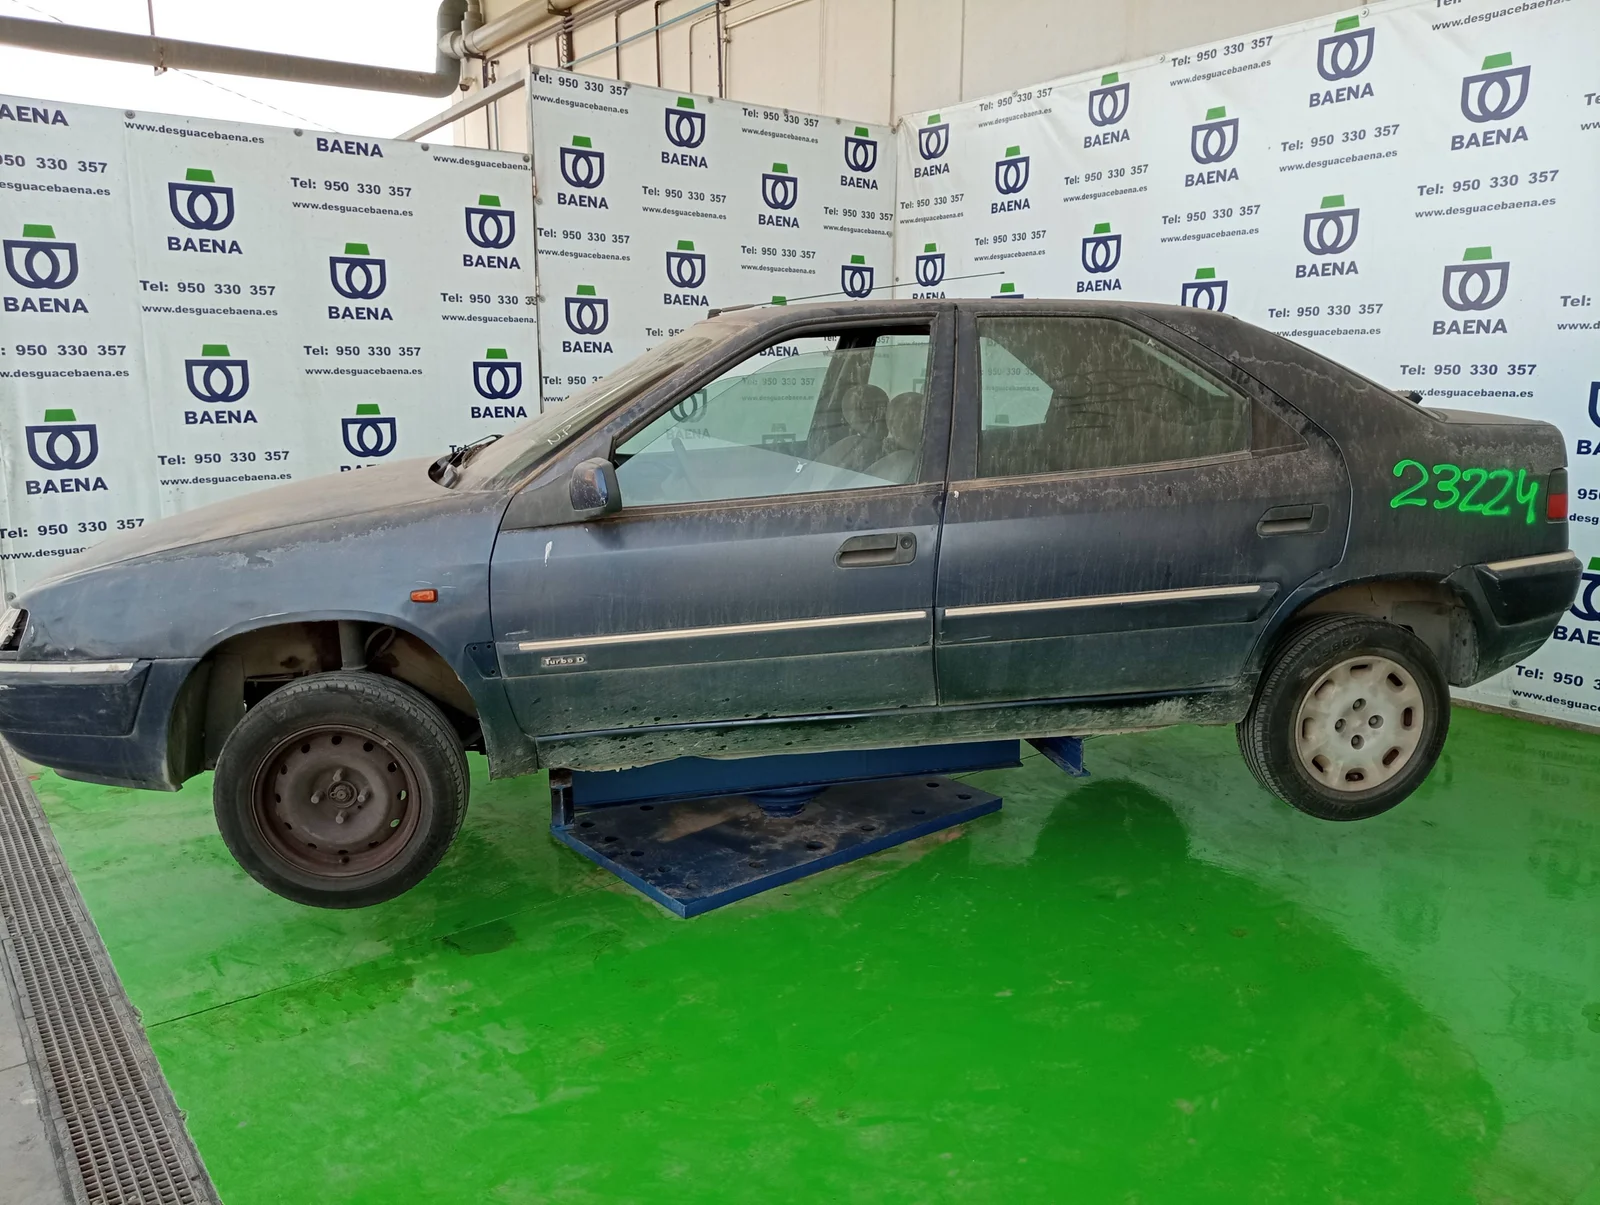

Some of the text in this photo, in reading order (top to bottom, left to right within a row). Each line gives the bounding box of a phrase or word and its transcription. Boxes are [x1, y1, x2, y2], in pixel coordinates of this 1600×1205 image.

[1172, 35, 1273, 68] Tel: 950 330 357
[1170, 59, 1271, 87] www.desguacebaena.es
[532, 72, 628, 96] Tel: 950 330 357
[979, 88, 1053, 112] Tel: 950 330 357
[1309, 82, 1374, 108] BAENA
[533, 94, 629, 114] www.desguacebaena.es
[742, 108, 819, 128] Tel: 950 330 357
[978, 107, 1052, 128] www.desguacebaena.es
[125, 121, 264, 144] www.desguacebaena.es
[742, 127, 818, 144] www.desguacebaena.es
[1084, 129, 1130, 149] BAENA
[1281, 124, 1400, 152] Tel: 950 330 357
[1451, 126, 1528, 151] BAENA
[316, 137, 383, 158] BAENA
[36, 157, 108, 173] 330 357
[661, 151, 708, 168] BAENA
[1279, 150, 1397, 172] www.desguacebaena.es
[914, 163, 950, 178] BAENA
[1064, 164, 1149, 185] Tel: 950 330 357
[1185, 167, 1239, 187] BAENA
[291, 177, 412, 197] Tel: 950 330 357
[841, 175, 878, 190] BAENA
[1417, 170, 1559, 196] Tel: 950 330 357
[557, 192, 609, 209] BAENA
[642, 186, 726, 203] Tel: 950 330 357
[900, 193, 964, 210] Tel: 950 330 357
[1063, 185, 1148, 203] www.desguacebaena.es
[292, 202, 413, 217] www.desguacebaena.es
[642, 206, 726, 220] www.desguacebaena.es
[824, 207, 893, 221] Tel: 950 330 357
[991, 198, 1030, 214] BAENA
[1415, 198, 1556, 218] www.desguacebaena.es
[759, 214, 799, 228] BAENA
[900, 211, 963, 224] www.desguacebaena.es
[1162, 204, 1261, 225] Tel: 950 330 357
[537, 228, 630, 244] Tel: 950 330 357
[975, 230, 1047, 246] Tel: 950 330 357
[1161, 227, 1259, 243] www.desguacebaena.es
[168, 237, 243, 254] BAENA
[741, 246, 815, 259] Tel: 950 330 357
[463, 254, 521, 269] BAENA
[538, 249, 630, 261] www.desguacebaena.es
[974, 249, 1045, 262] www.desguacebaena.es
[741, 264, 815, 274] www.desguacebaena.es
[1296, 261, 1359, 279] BAENA
[139, 280, 276, 296] Tel: 950 330 357
[1077, 278, 1122, 293] BAENA
[4, 297, 89, 313] BAENA
[441, 293, 463, 302] Tel:
[469, 295, 491, 304] 950
[498, 296, 518, 305] 330
[664, 294, 709, 306] BAENA
[1560, 295, 1592, 307] Tel:
[142, 305, 278, 316] www.desguacebaena.es
[328, 306, 393, 321] BAENA
[1268, 303, 1383, 318] Tel: 950 330 357
[646, 328, 663, 337] Tel:
[1433, 319, 1508, 335] BAENA
[15, 345, 127, 356] 950 330 357
[304, 346, 421, 356] Tel: 950 330 357
[562, 341, 613, 353] BAENA
[305, 368, 423, 376] www.desguacebaena.es
[1401, 364, 1537, 376] Tel: 950 330 357
[543, 376, 561, 385] Tel:
[568, 376, 586, 385] 950
[184, 410, 258, 425] BAENA
[471, 406, 527, 418] BAENA
[158, 451, 290, 465] Tel: 950 330 357
[26, 477, 109, 495] BAENA
[160, 473, 292, 485] www.desguacebaena.es
[1390, 459, 1538, 524] 23224
[0, 518, 145, 539] Tel: 950 330 357
[1516, 665, 1583, 686] Tel: 950
